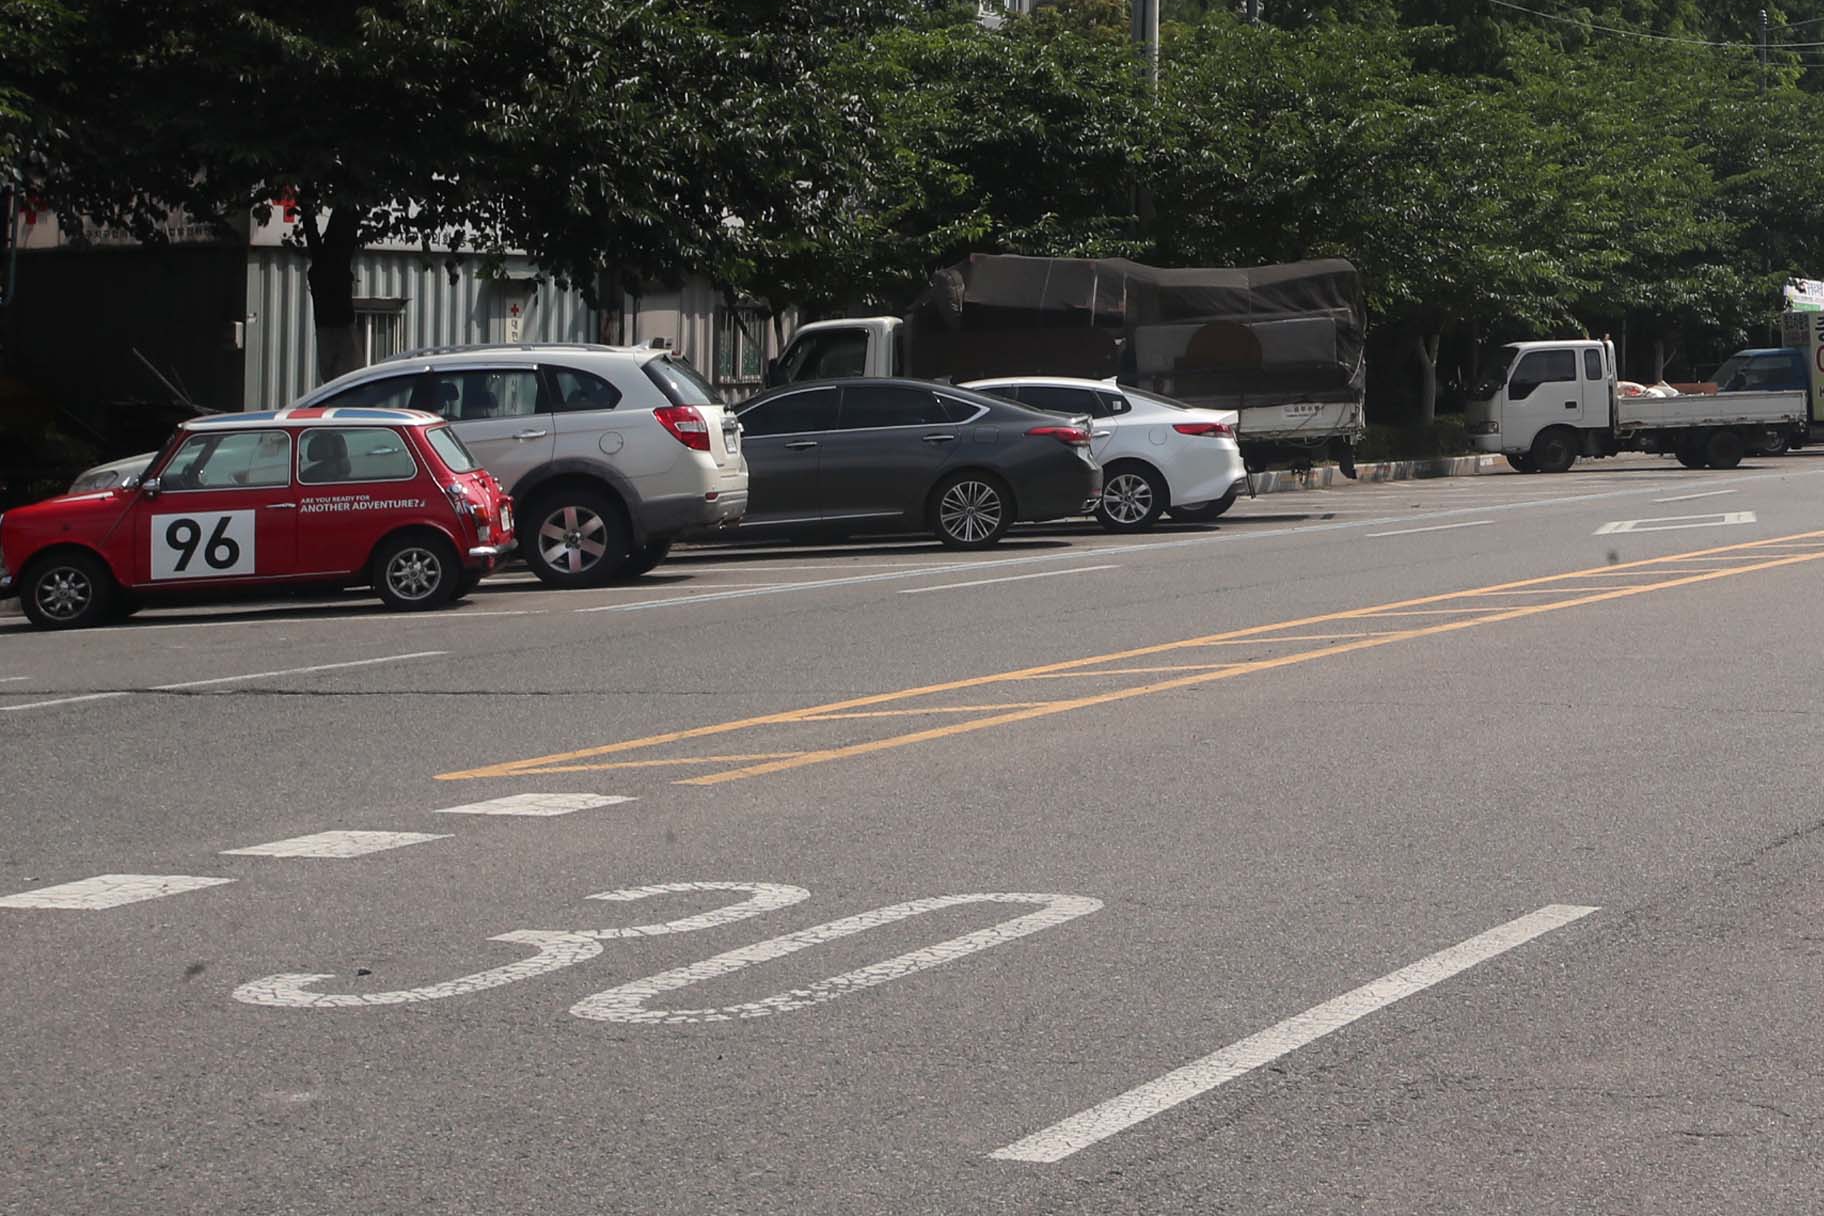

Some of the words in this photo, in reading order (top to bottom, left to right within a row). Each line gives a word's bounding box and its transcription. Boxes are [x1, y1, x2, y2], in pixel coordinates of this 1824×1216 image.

[300, 502, 350, 513] ANOTHER
[352, 499, 419, 511] ADVENTURE?
[166, 516, 240, 572] 96
[231, 880, 1104, 1025] 30
